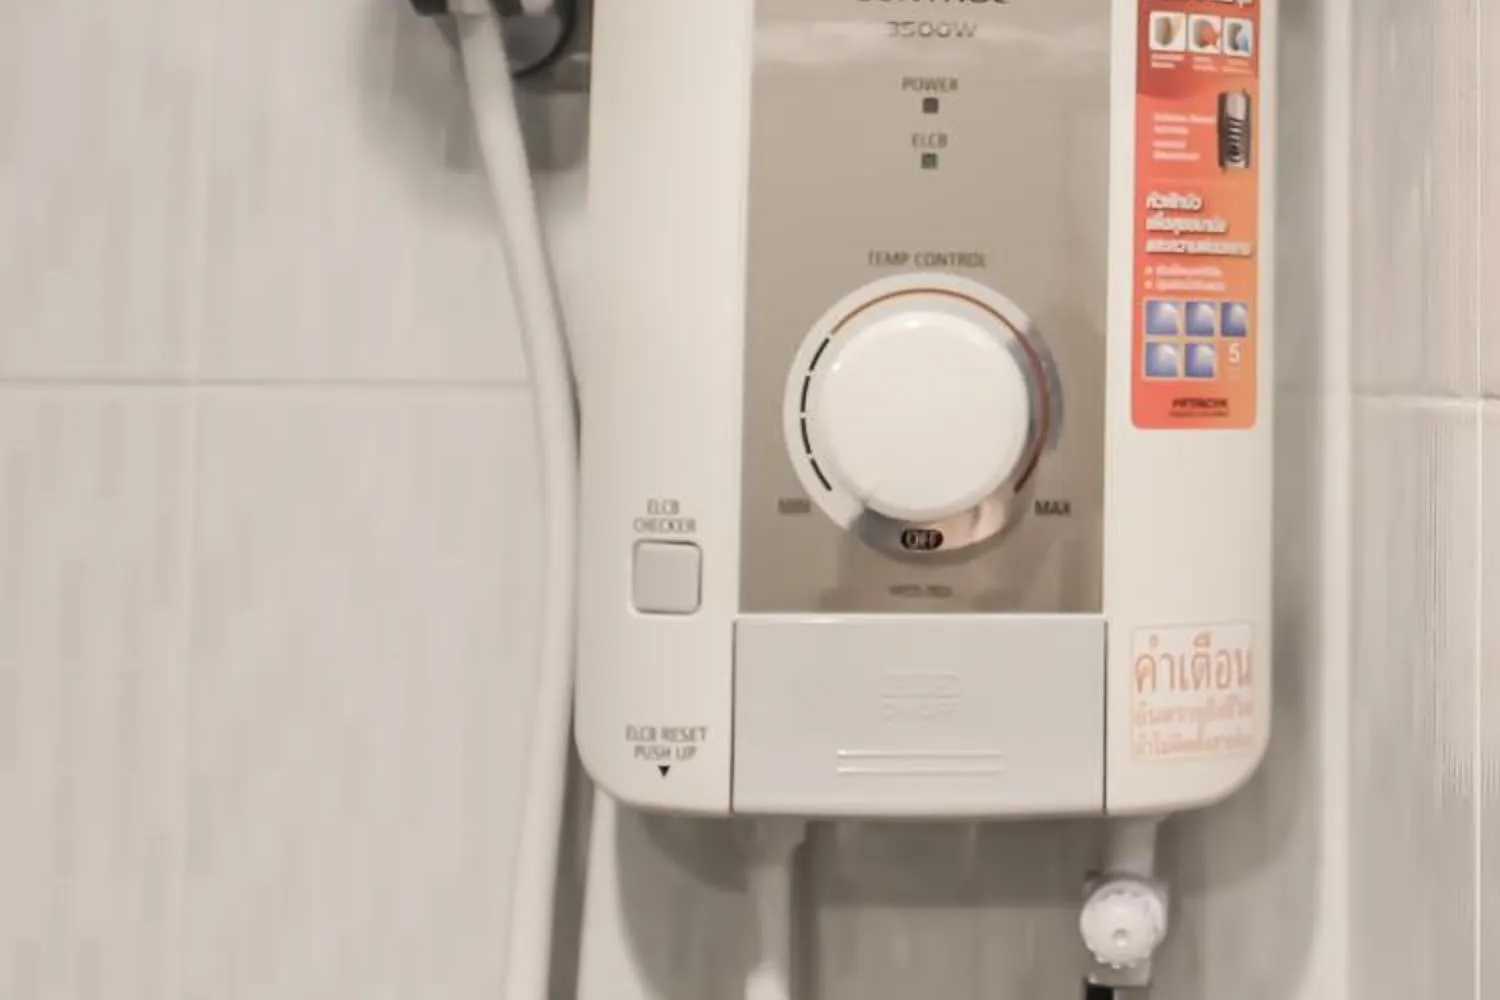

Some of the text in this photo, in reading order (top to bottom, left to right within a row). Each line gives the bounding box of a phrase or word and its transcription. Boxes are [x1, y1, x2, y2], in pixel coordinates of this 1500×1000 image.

[886, 21, 978, 39] 3500W
[902, 76, 959, 93] POWER
[911, 132, 949, 150] ELCB
[867, 250, 988, 269] TEMP CONTROL
[1227, 342, 1241, 364] 5
[1035, 500, 1072, 517] MAX
[632, 517, 697, 535] CHECKER
[905, 530, 940, 549] OFF
[660, 725, 707, 743] RESET
[633, 744, 699, 762] PUSH UP
